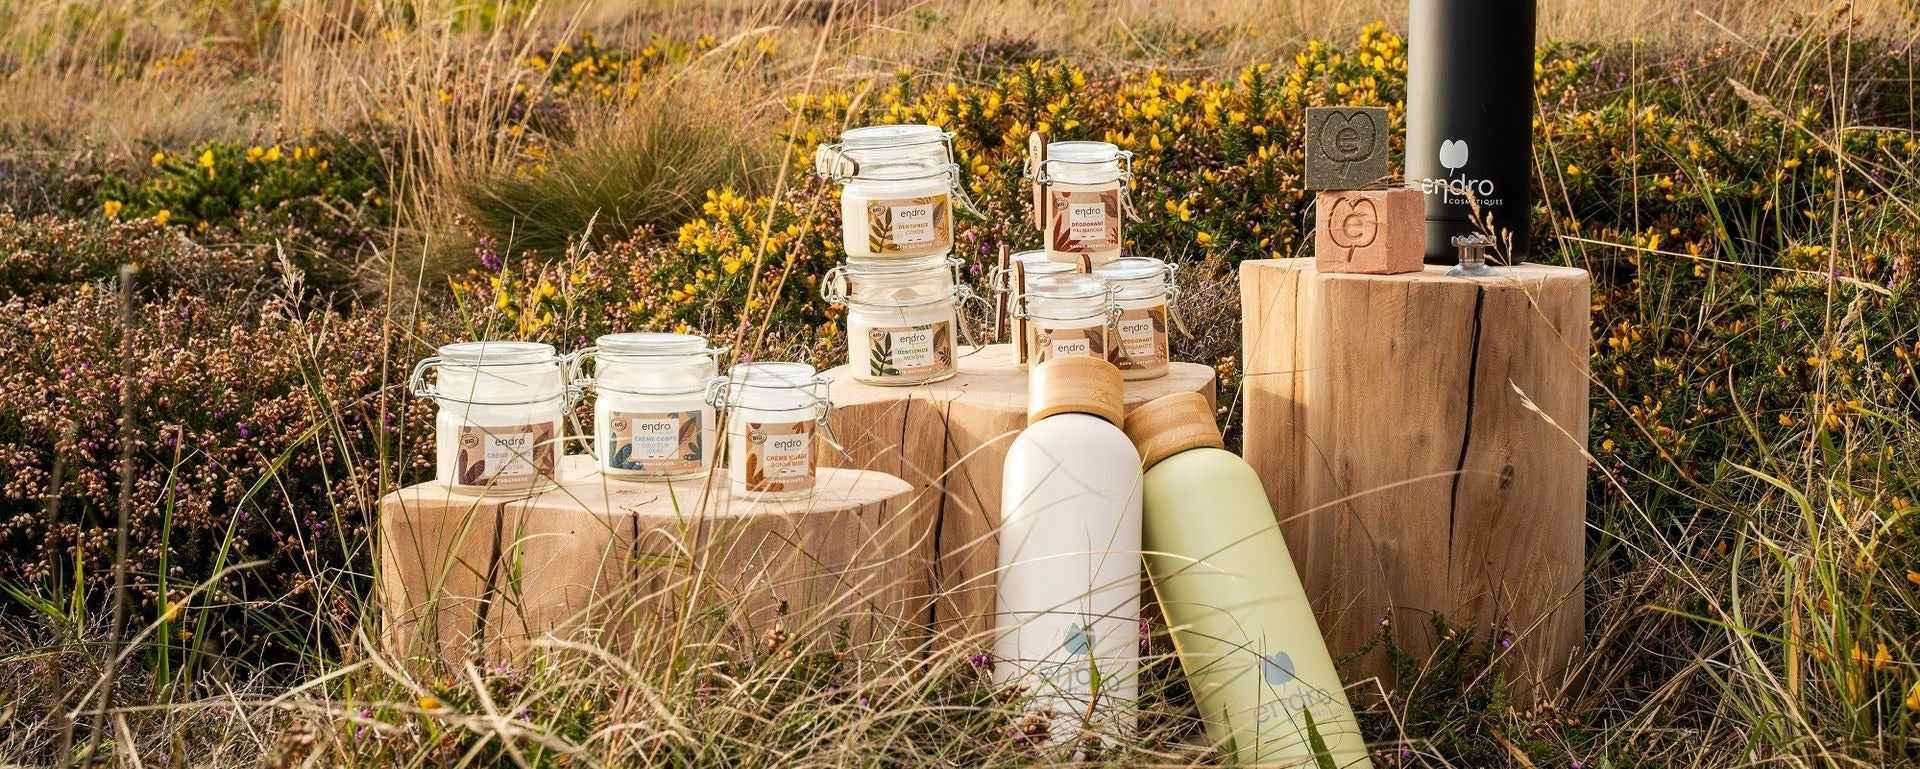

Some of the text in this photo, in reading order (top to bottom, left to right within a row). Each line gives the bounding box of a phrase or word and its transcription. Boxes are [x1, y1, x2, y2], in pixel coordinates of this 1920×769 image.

[1421, 173, 1494, 204] endro
[1448, 198, 1503, 206] COSMTIQUES
[900, 208, 926, 219] endro
[1075, 207, 1101, 218] endro
[1123, 321, 1149, 334] endro
[900, 333, 926, 345] endro
[1057, 343, 1086, 354] endro
[641, 422, 671, 433] endro
[774, 439, 802, 451] endro
